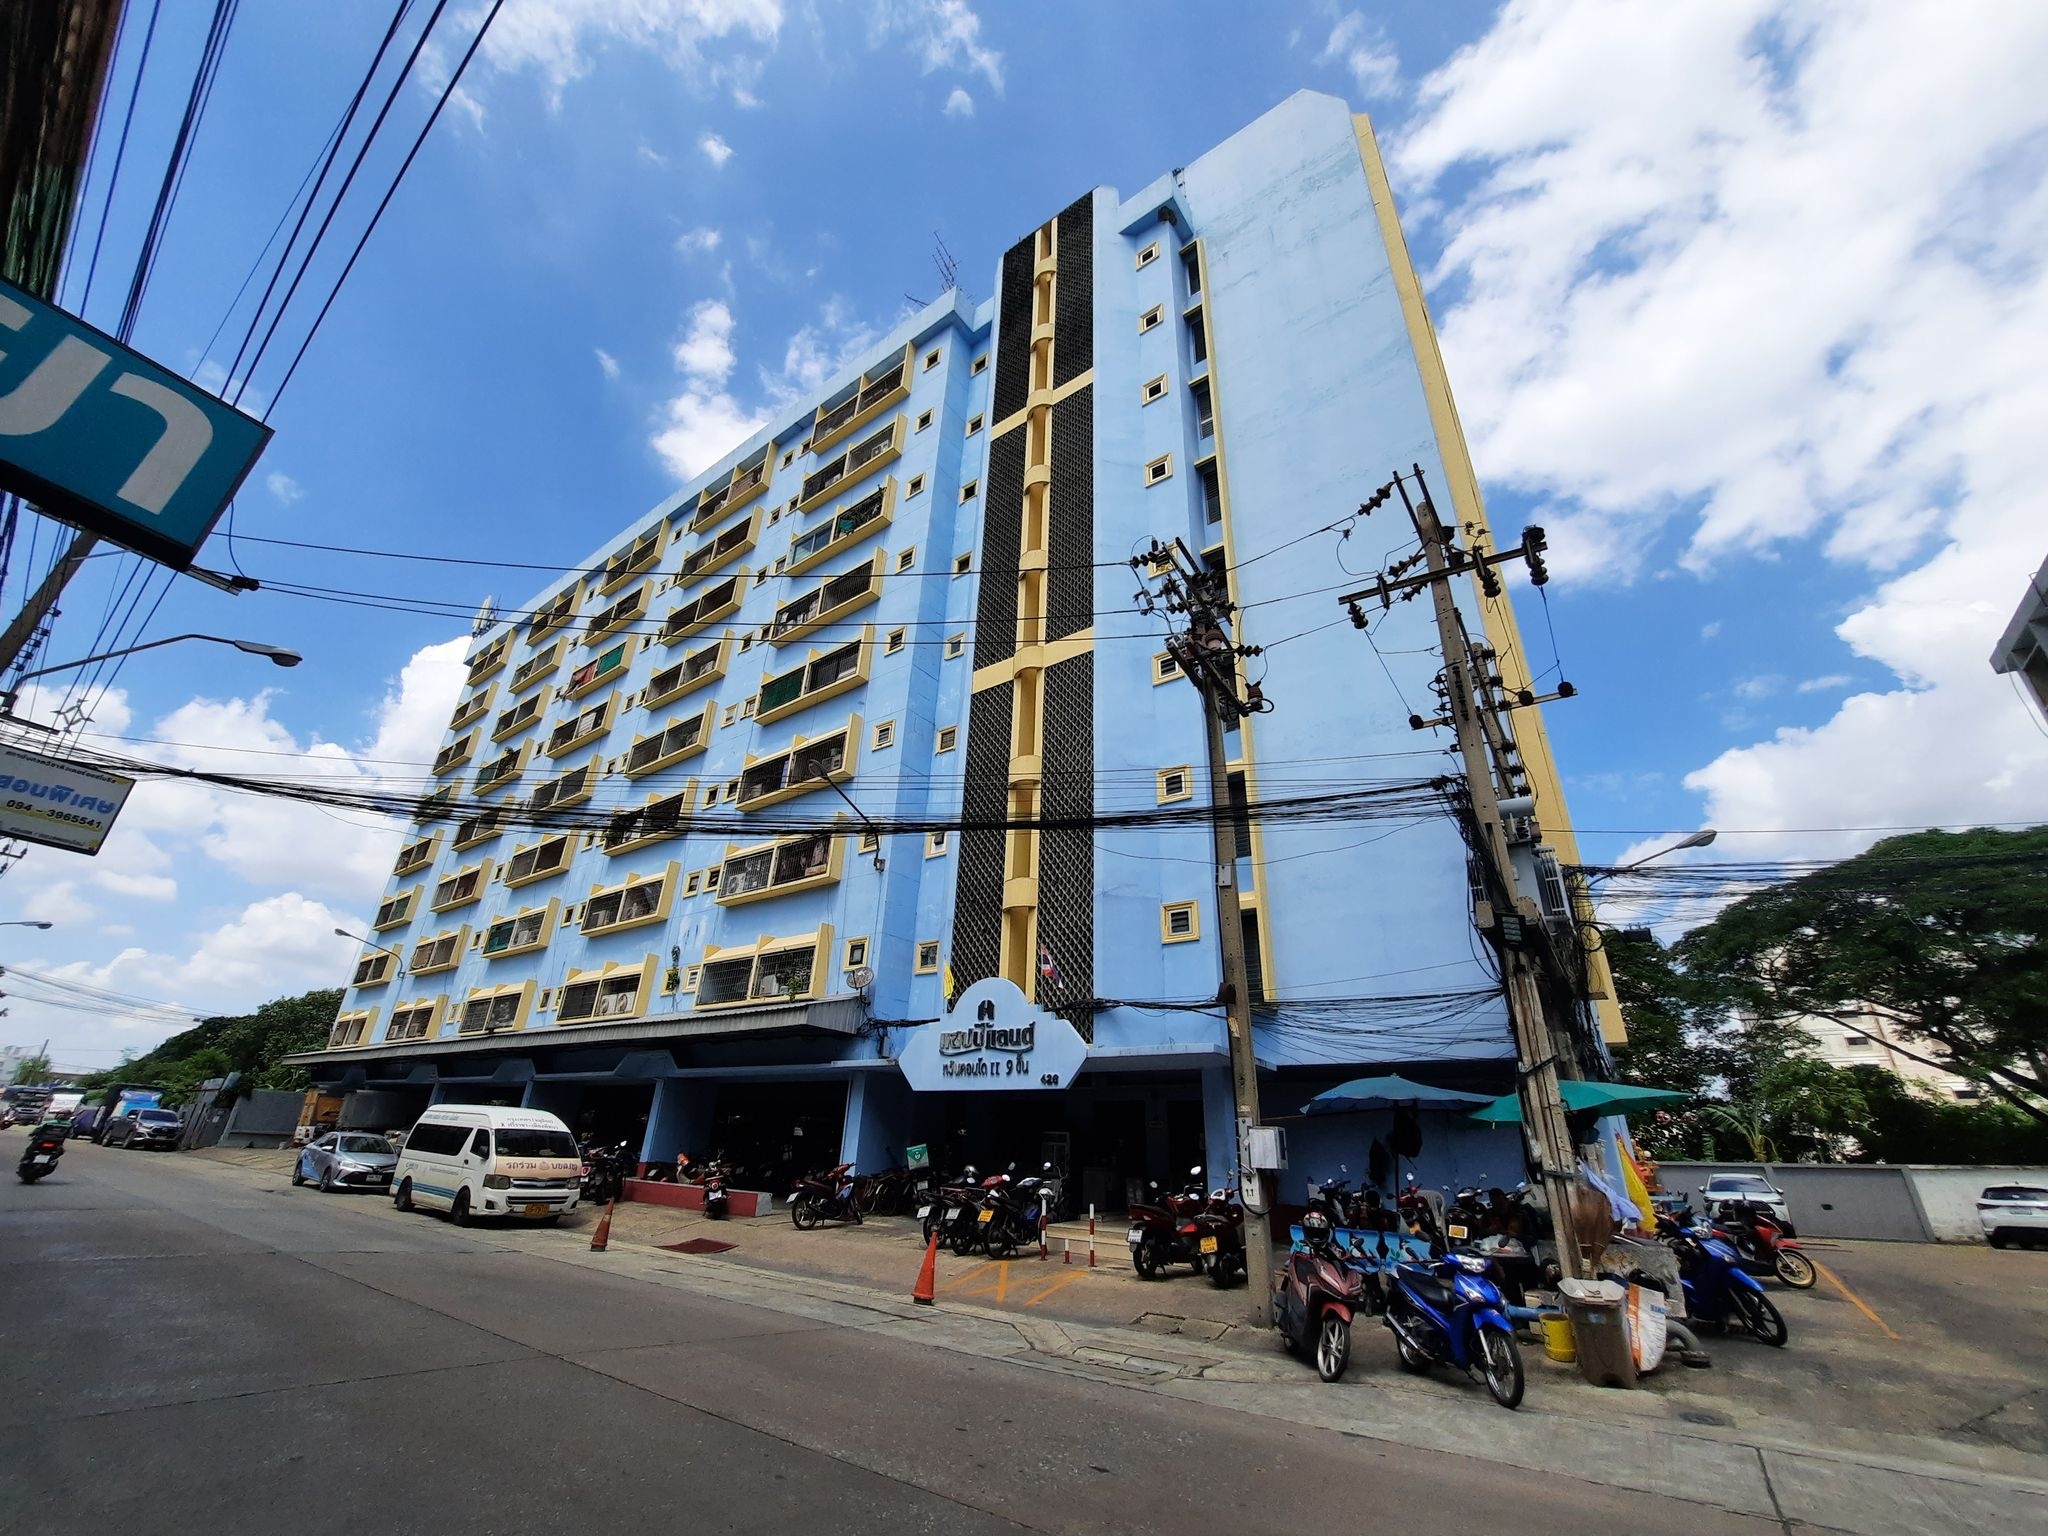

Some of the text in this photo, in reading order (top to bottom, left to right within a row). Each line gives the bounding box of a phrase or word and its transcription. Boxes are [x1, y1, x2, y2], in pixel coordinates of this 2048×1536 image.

[6, 799, 33, 812] 094
[46, 809, 103, 828] 3965541
[1006, 1059, 1013, 1076] 9
[506, 1161, 537, 1170] รถร่วม
